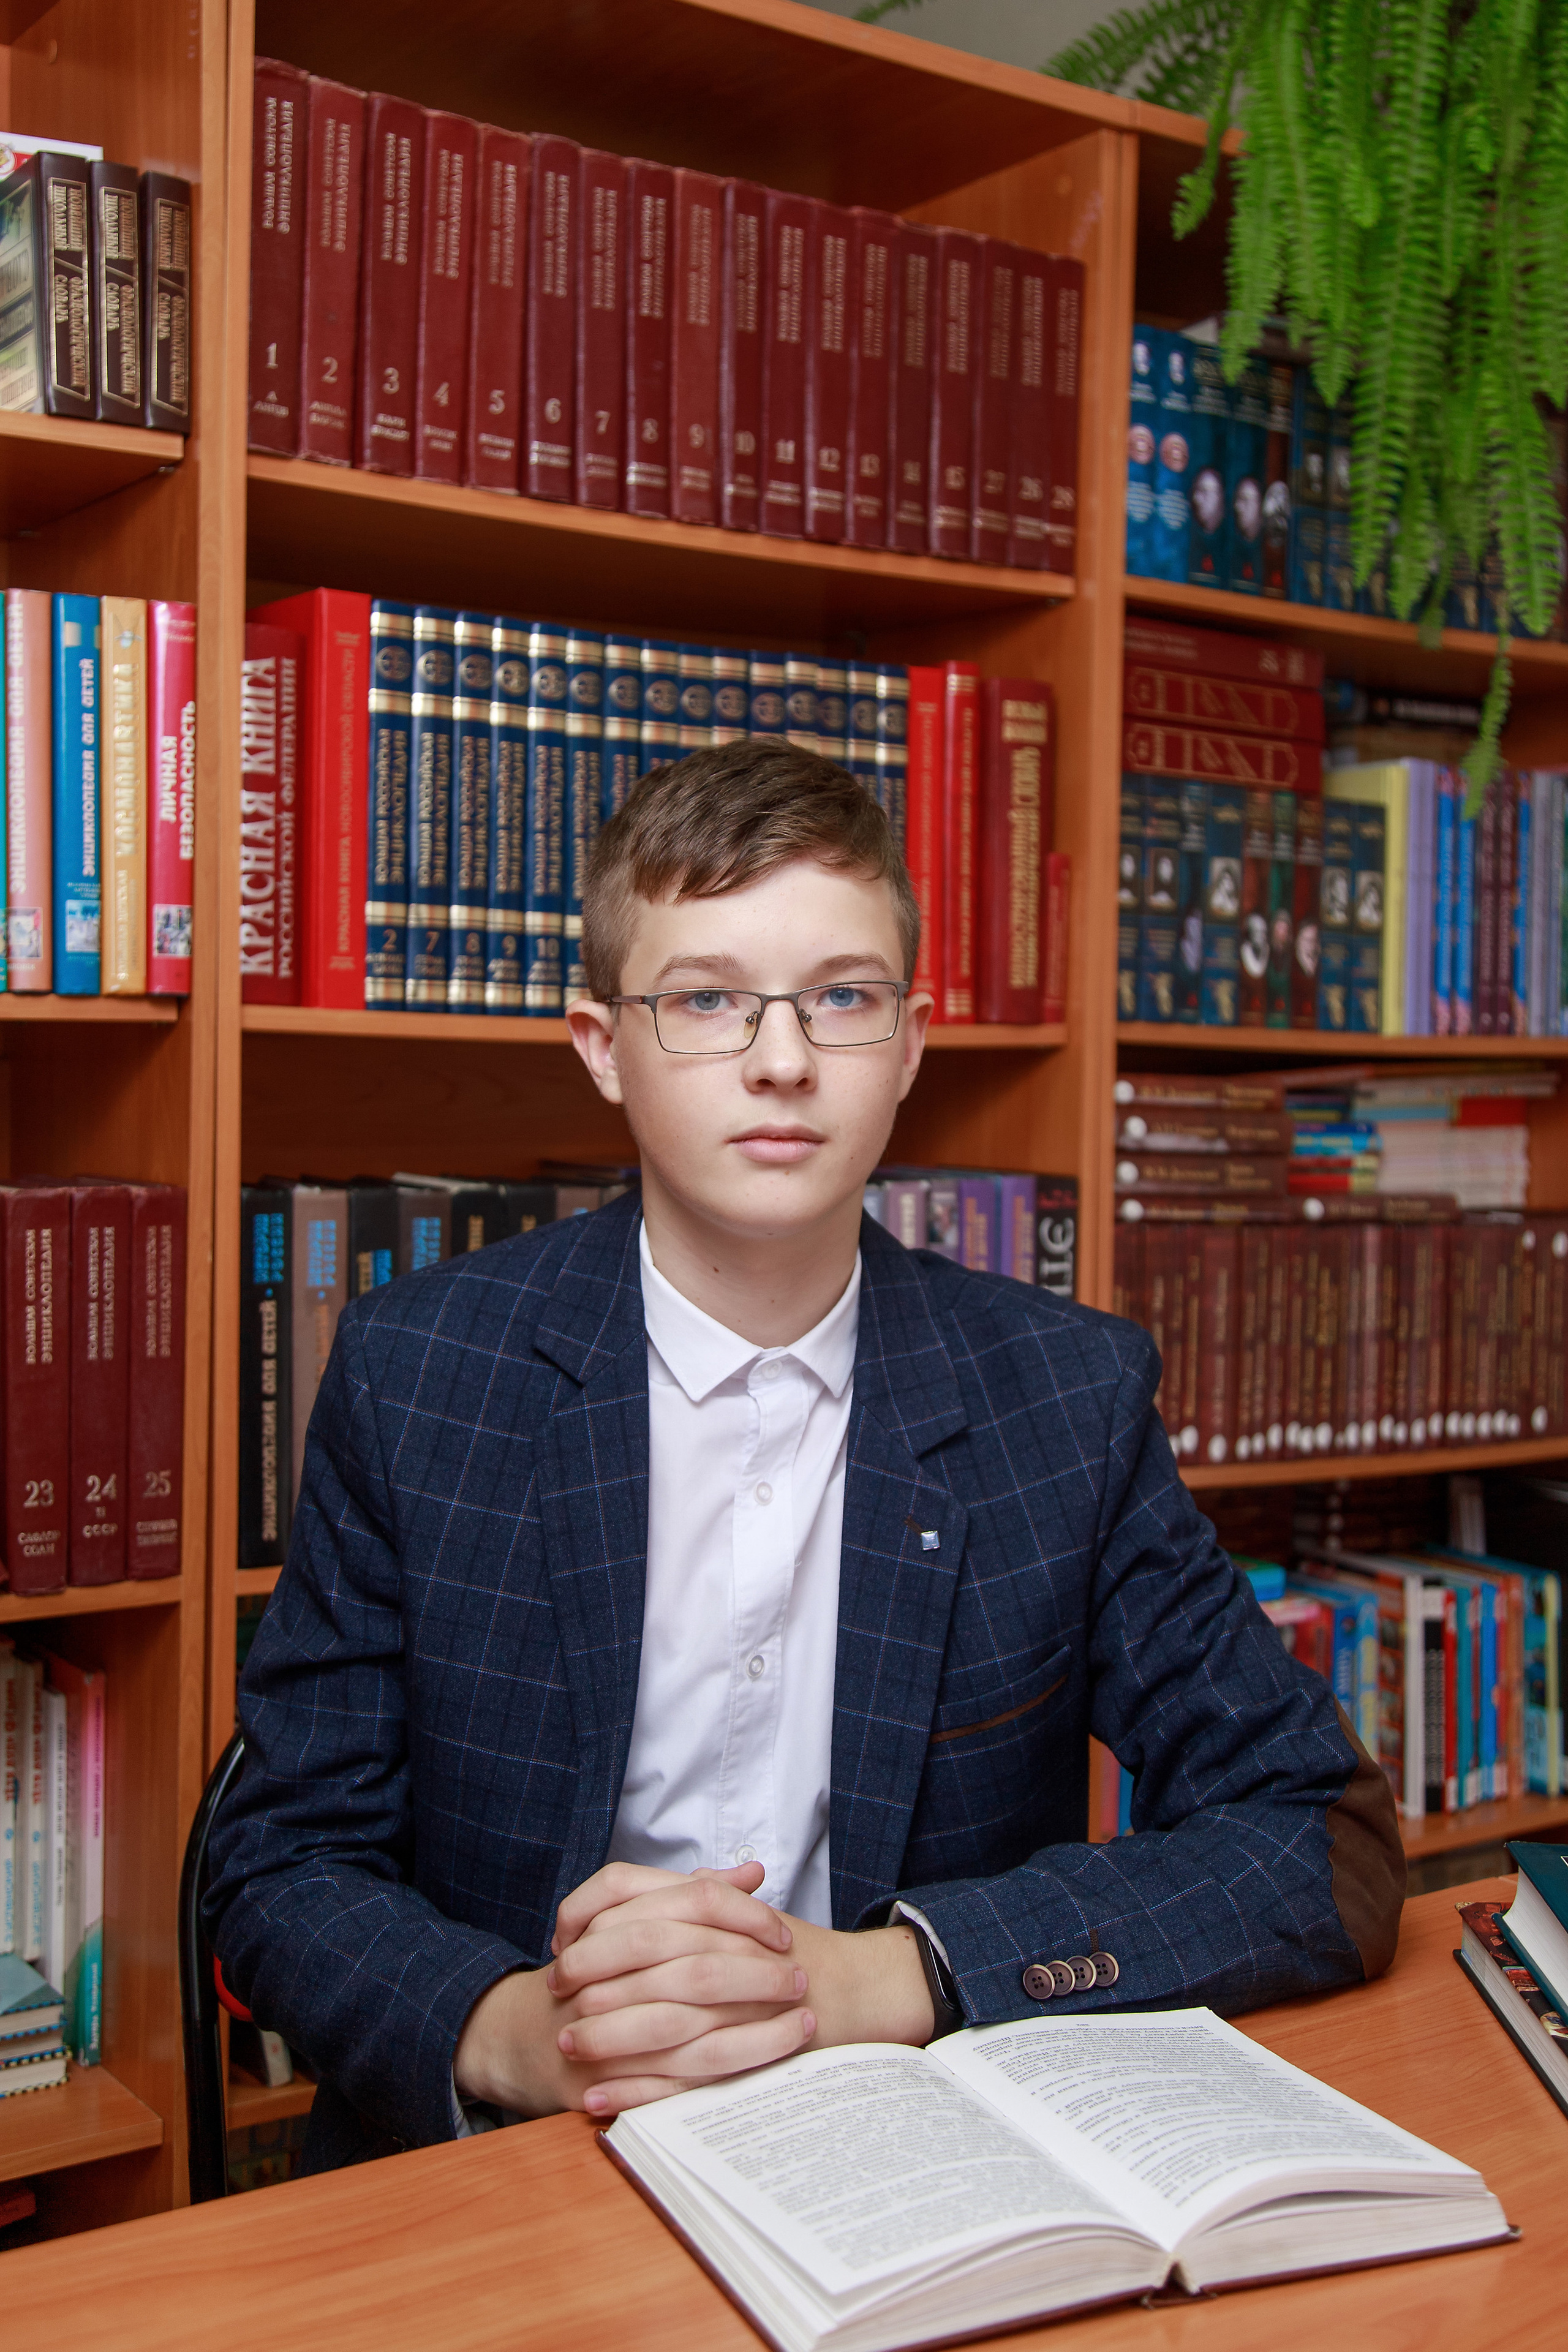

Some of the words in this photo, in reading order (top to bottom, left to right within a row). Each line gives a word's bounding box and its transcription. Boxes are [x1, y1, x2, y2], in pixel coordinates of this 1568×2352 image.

[264, 97, 277, 166] СОВЕТСКАЯ
[277, 100, 293, 234] ЭНЦИКЛОПЕДИЯ
[262, 172, 275, 228] БОЛЬШАЯ
[333, 123, 351, 252] ЭНЦИКЛОПЕДИЯ
[394, 138, 411, 265] ЭНЦИКЛОПЕДИЯ
[53, 184, 70, 251] ШКОЛЬНЫЙ
[55, 274, 69, 323] СЛОВАРЬ
[106, 282, 120, 331] СЛОВАРЬ
[266, 342, 278, 369] 1
[322, 356, 338, 383] 2
[382, 367, 399, 394] 3
[432, 382, 450, 407] 4
[488, 389, 505, 415] 5
[545, 398, 562, 424] 6
[595, 410, 611, 435] 7
[642, 418, 659, 443] 8
[688, 423, 706, 448] 9
[79, 658, 95, 709] ДЕТЕЙ
[81, 712, 95, 745] ДЛЯ
[240, 656, 276, 775] КНИГА
[280, 657, 296, 805] ФЕДЕРАЦИИ
[160, 736, 177, 823] ЛИЧНАЯ
[179, 701, 195, 859] БЕЗОПАСНОСТЬ
[81, 749, 96, 876] ЭНЦИКЛОПЕДИЯ
[240, 790, 276, 976] КРАСНАЯ
[277, 812, 294, 978] РОССИЙСКОЙ
[382, 928, 397, 952] 2
[426, 931, 440, 953] 7
[503, 935, 517, 956] 9
[537, 937, 560, 958] 10
[40, 1229, 53, 1365] ЭНЦИКЛОПЕДИЯ
[23, 1479, 54, 1509] 23
[86, 1473, 117, 1502] 24
[143, 1470, 171, 1498] 25
[83, 1523, 118, 1539] СССР
[973, 2037, 1011, 2051] Штольцу
[1017, 2068, 1050, 2084] полтора
